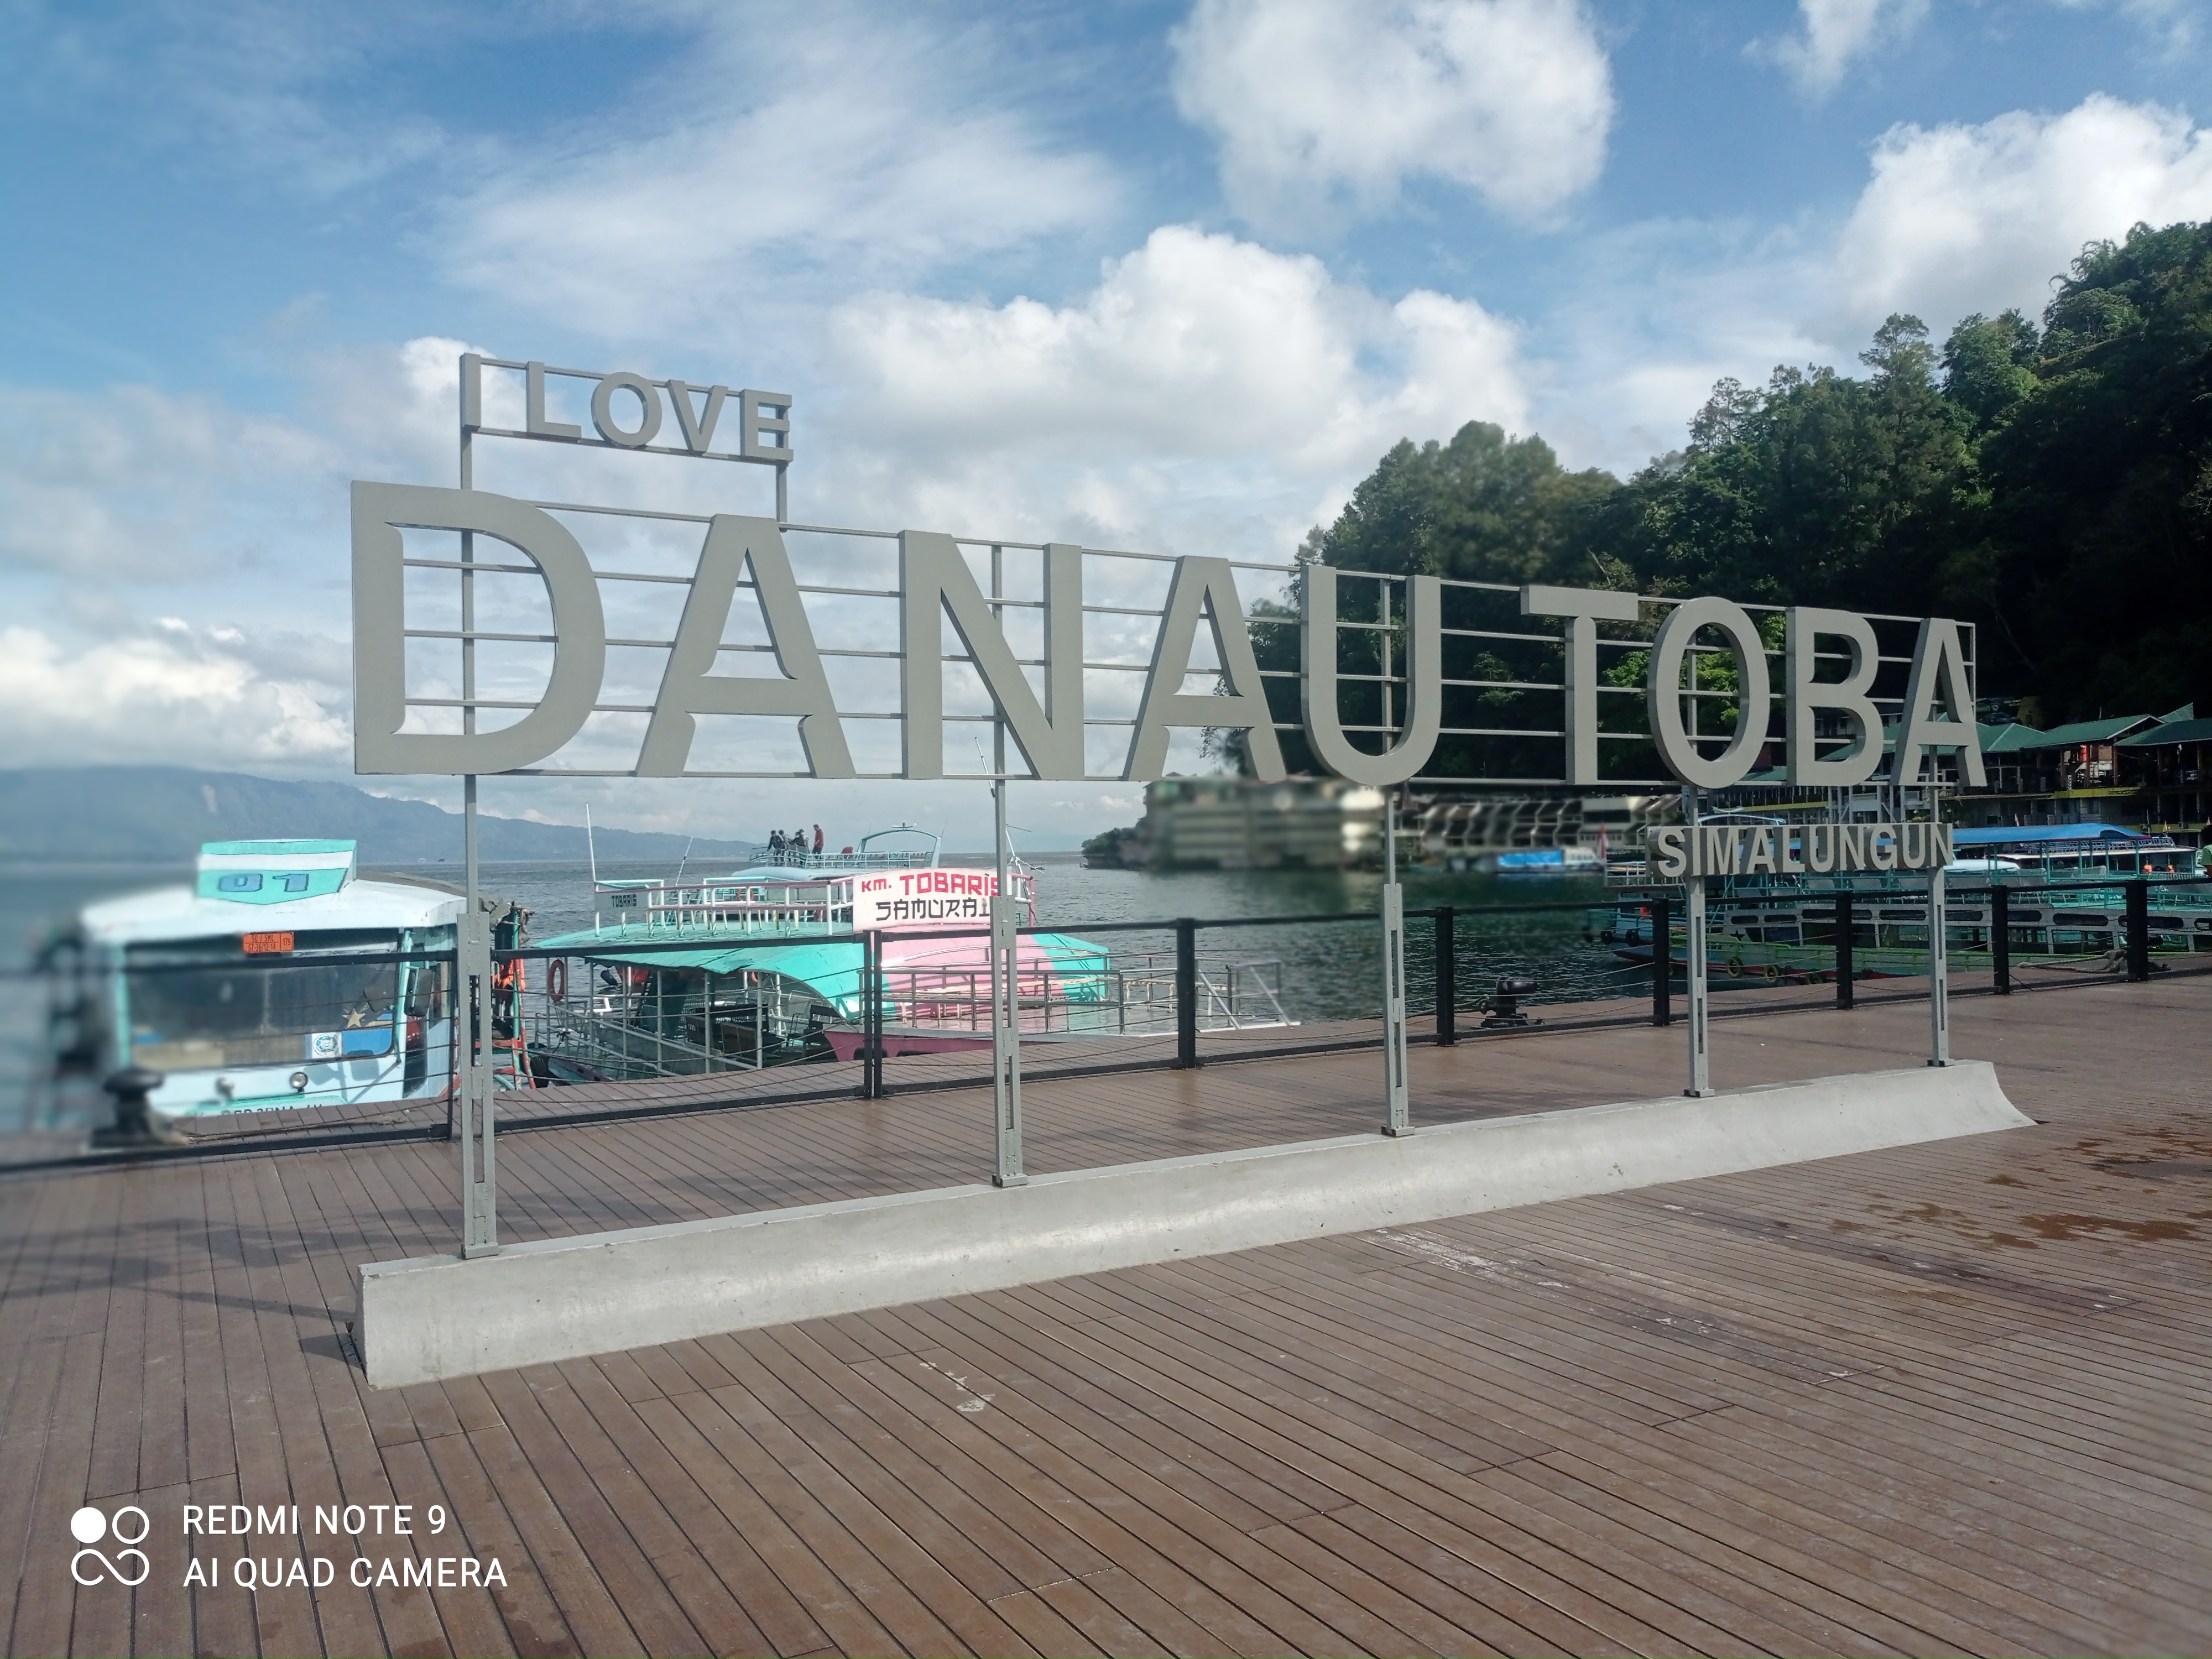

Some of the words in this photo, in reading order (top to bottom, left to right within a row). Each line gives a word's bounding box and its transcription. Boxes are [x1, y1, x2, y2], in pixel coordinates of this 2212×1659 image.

[460, 353, 481, 432] I
[526, 361, 794, 462] LOVE
[351, 480, 1442, 785] DANAU
[1521, 585, 1987, 789] TOBA
[1648, 824, 1954, 878] SIMALUNGUN
[218, 873, 309, 892] 01
[900, 872, 998, 896] TOBARIS
[612, 894, 637, 907] TOBARIS
[876, 897, 990, 921] SAMURAI
